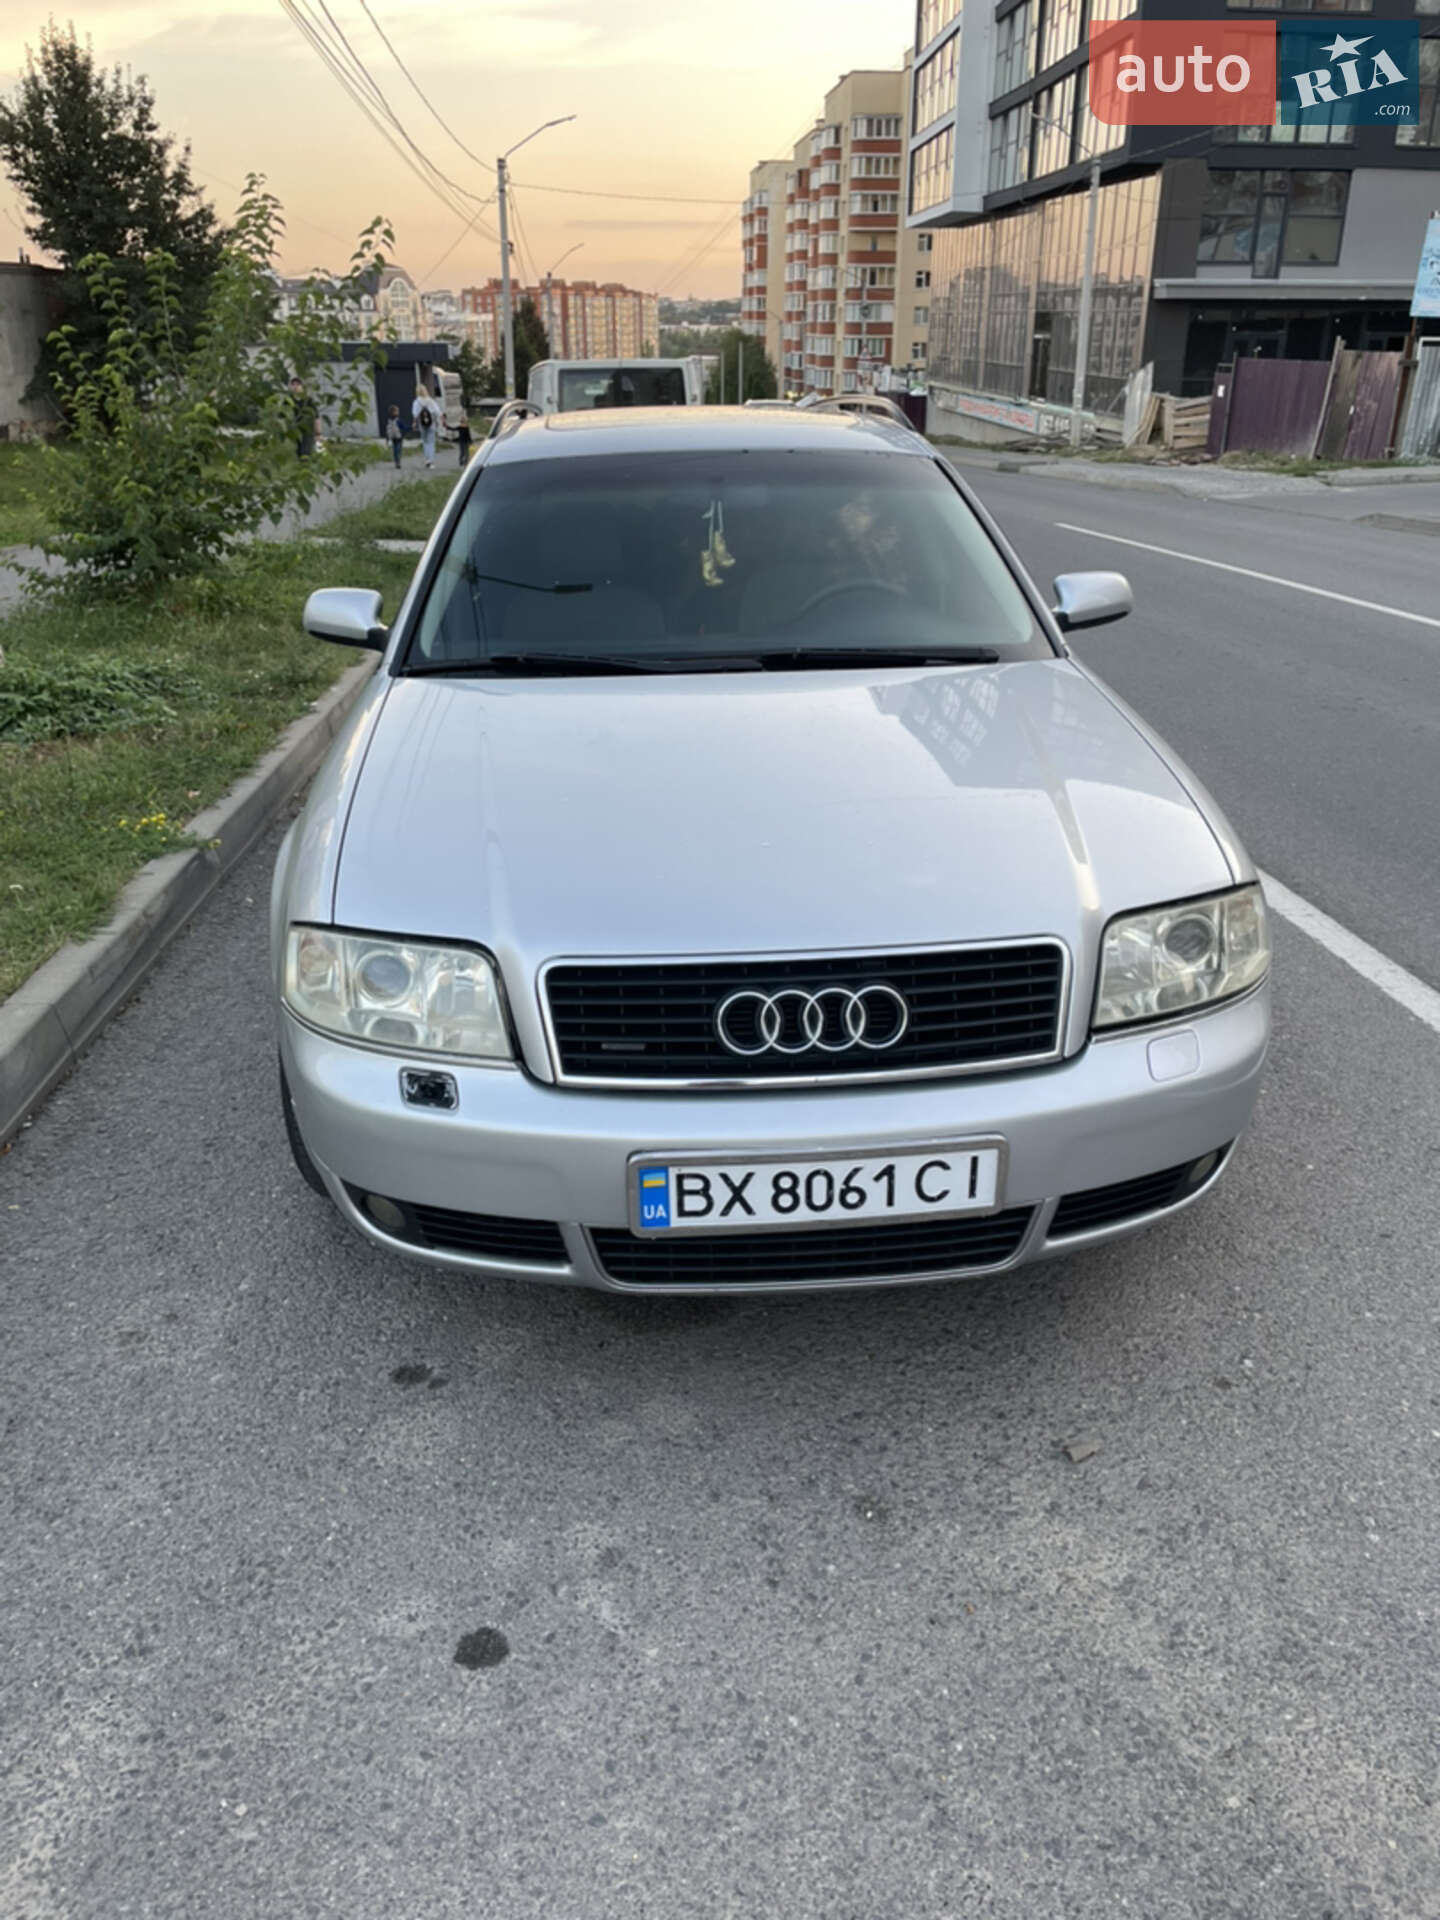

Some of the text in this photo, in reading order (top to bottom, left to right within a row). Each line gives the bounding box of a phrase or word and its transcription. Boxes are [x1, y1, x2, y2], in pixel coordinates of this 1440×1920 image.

[675, 1172, 756, 1218] BX
[771, 1163, 896, 1214] 8061
[643, 1203, 667, 1219] UA
